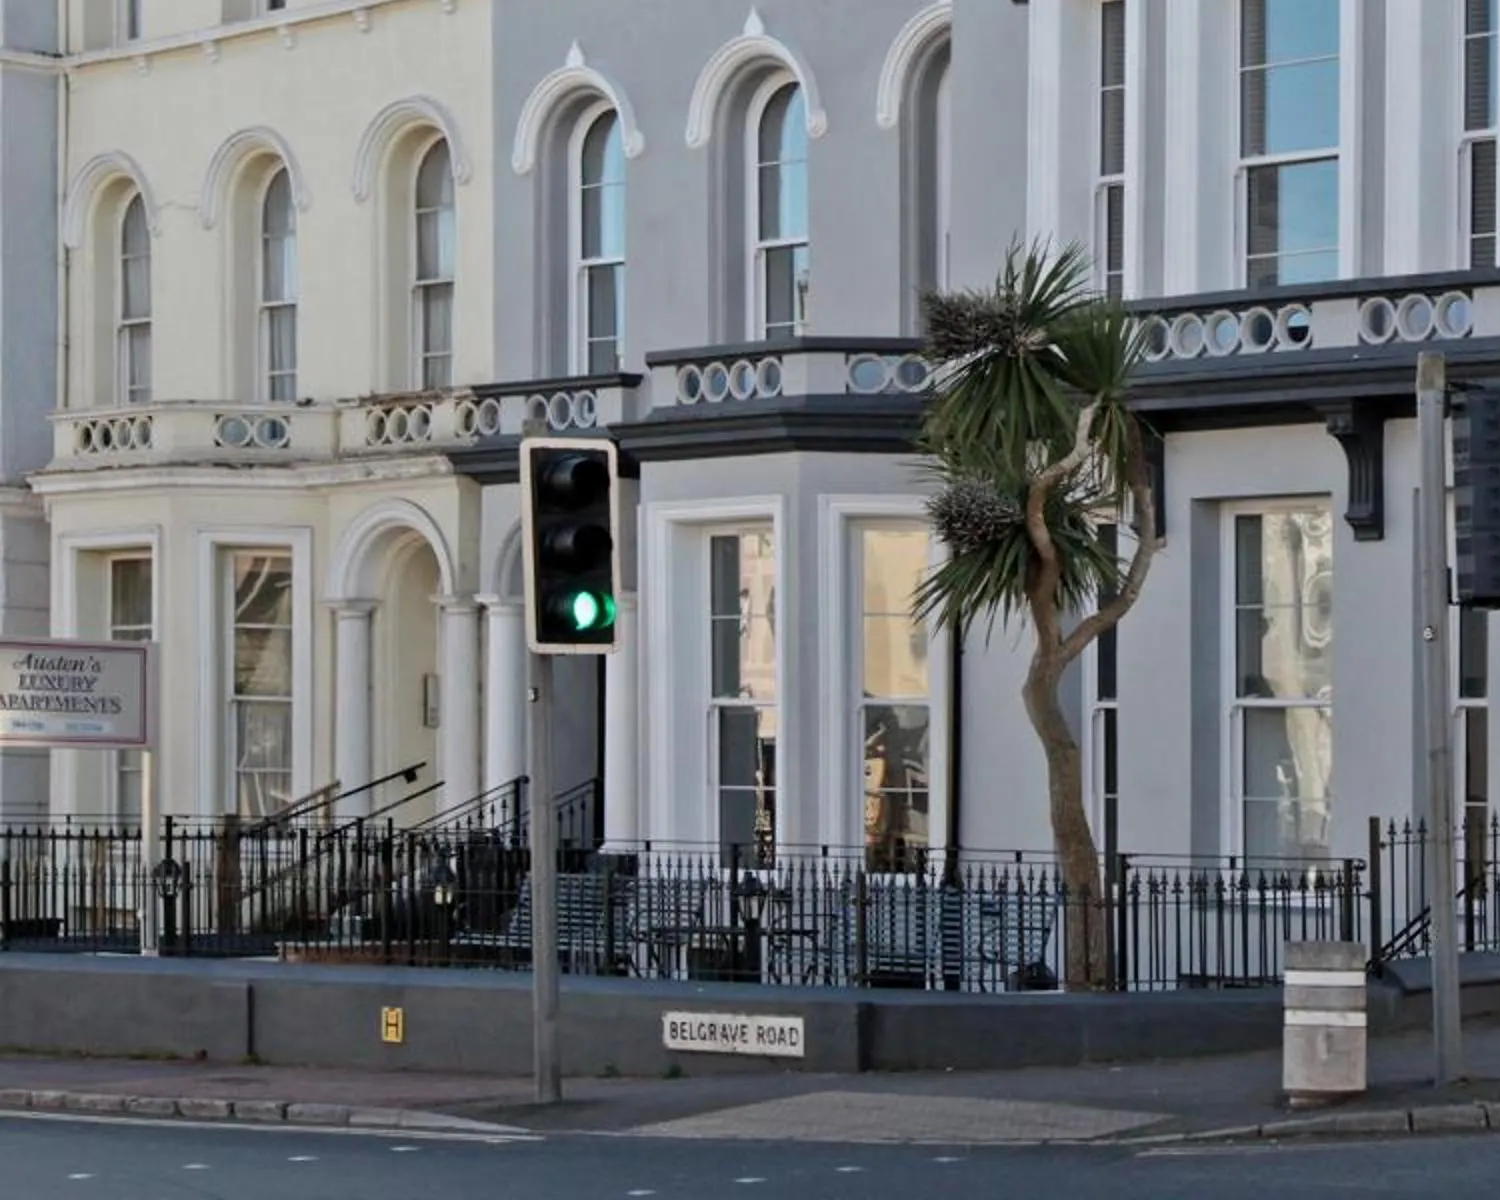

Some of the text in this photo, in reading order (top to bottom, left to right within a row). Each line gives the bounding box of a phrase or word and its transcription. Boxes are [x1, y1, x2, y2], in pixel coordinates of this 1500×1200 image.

[12, 653, 102, 673] Austen's
[19, 674, 97, 693] LUXURY
[669, 1021, 799, 1047] BELGRAVE ROAD
